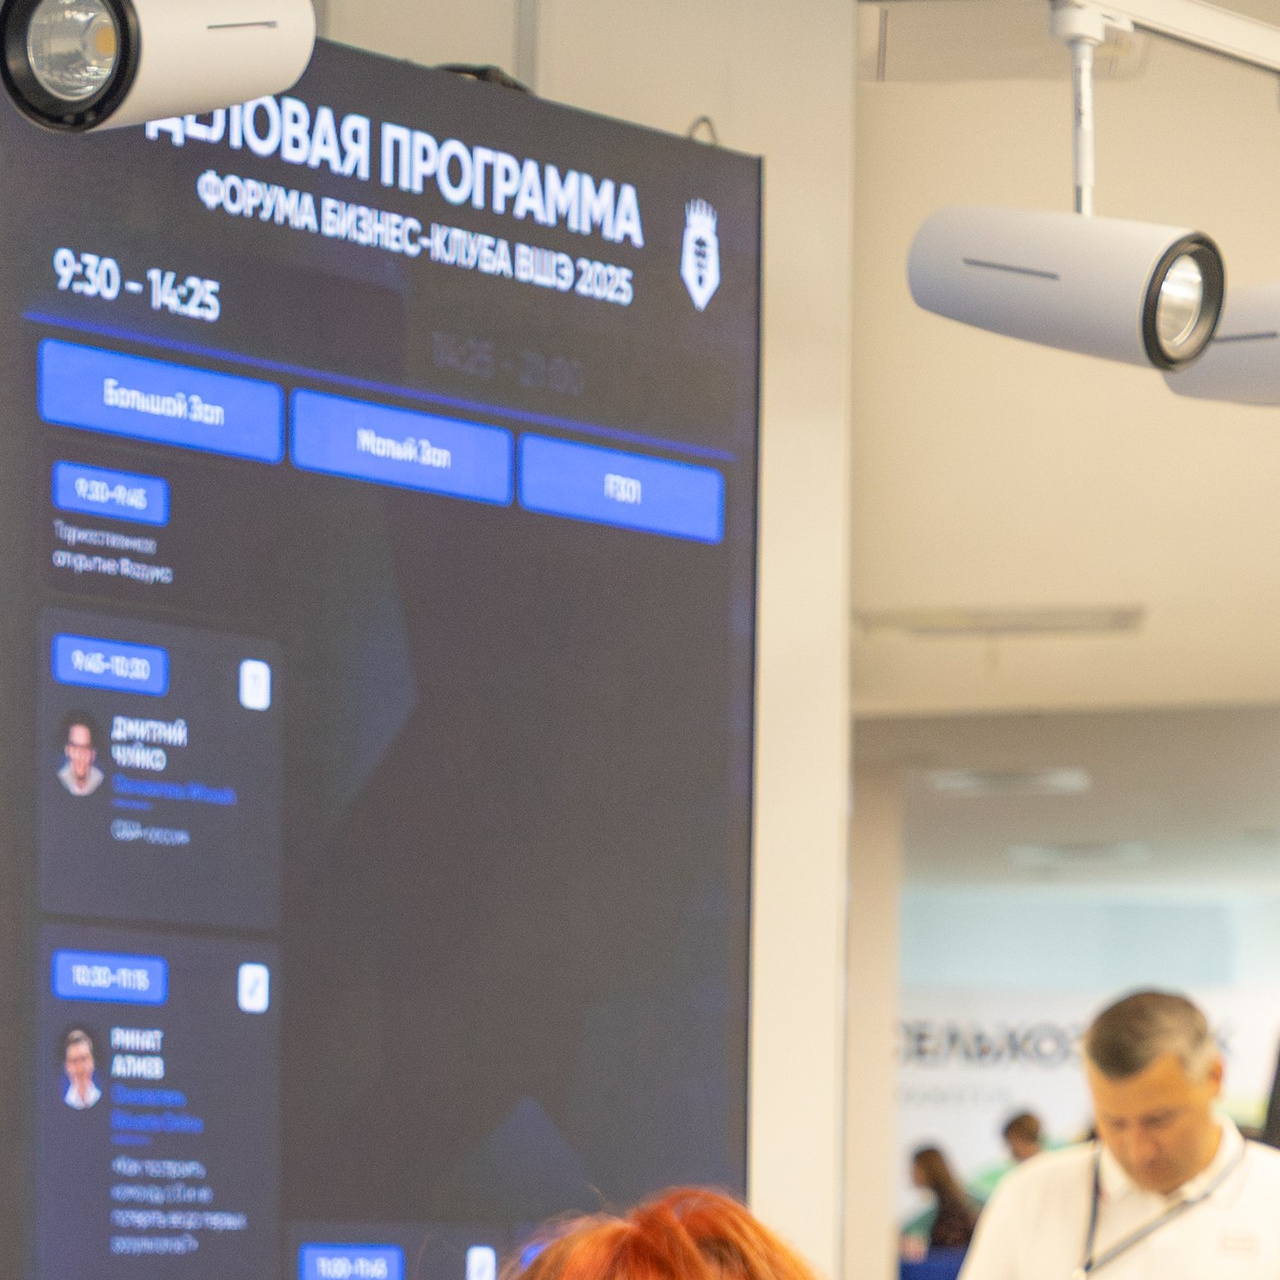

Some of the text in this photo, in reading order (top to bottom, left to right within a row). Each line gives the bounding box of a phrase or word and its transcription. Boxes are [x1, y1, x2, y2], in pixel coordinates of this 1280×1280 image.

[196, 169, 634, 306] ФОРУМА БИЗНЕС-КЛУБА ВШЭ 2025
[381, 122, 645, 249] ПРОГРАММА
[53, 247, 121, 300] 9:30
[146, 267, 220, 322] 14:25
